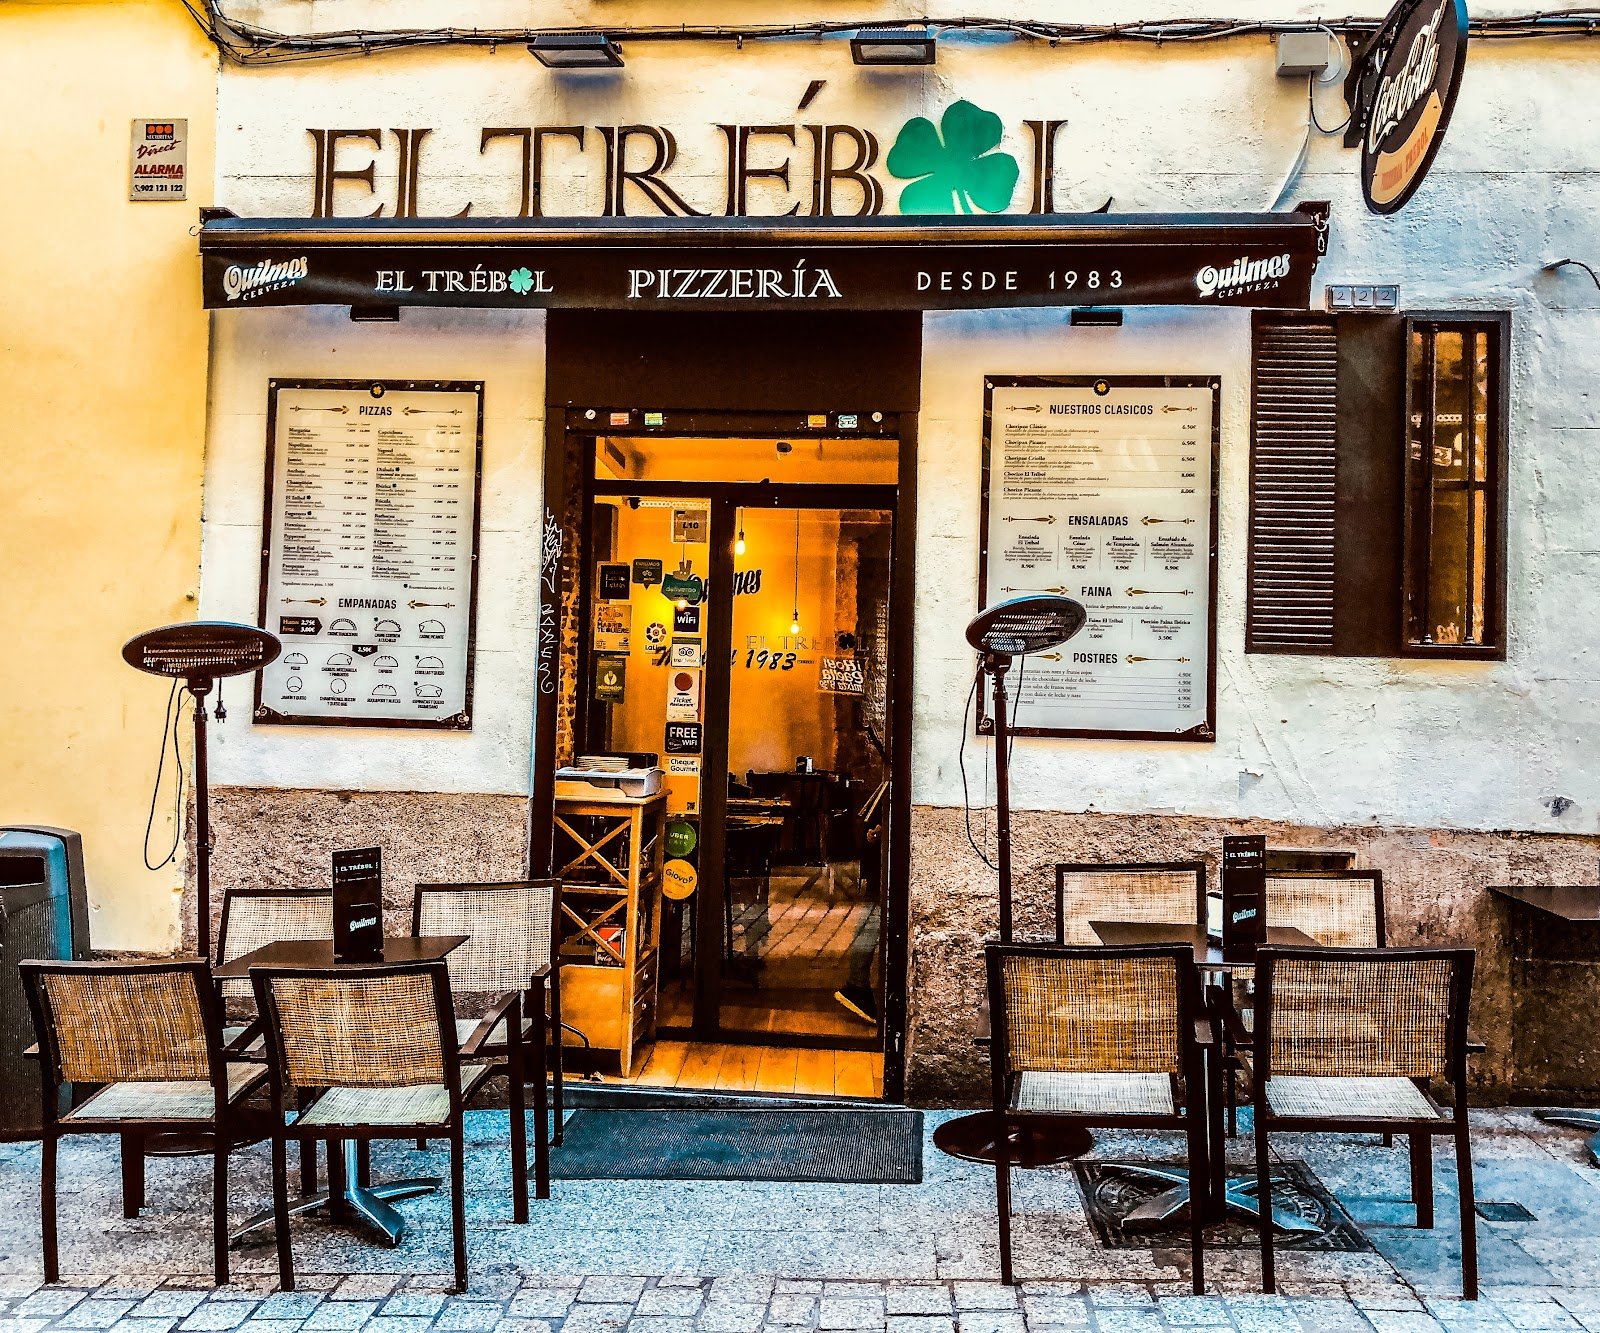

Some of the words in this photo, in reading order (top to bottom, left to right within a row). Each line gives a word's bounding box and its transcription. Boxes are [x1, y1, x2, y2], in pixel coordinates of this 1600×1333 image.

[136, 140, 182, 159] Direct
[305, 127, 473, 217] EL
[480, 80, 1113, 217] TRÉBL
[134, 164, 184, 174] ALARMA
[222, 256, 309, 302] Quilmes
[376, 270, 414, 292] EL
[422, 263, 554, 296] TRÉBL
[627, 259, 843, 300] PIZZERÍA
[916, 270, 1018, 291] DESDE
[1048, 270, 1124, 290] 1983
[1196, 254, 1290, 298] Quilmes
[242, 280, 296, 301] CERVEZA
[1218, 280, 1280, 299] CERVEZA
[360, 406, 392, 416] PIZZAS
[1050, 404, 1102, 415] NUESTROS
[1104, 405, 1153, 415] CLASICOS
[1068, 515, 1129, 526] ENSALADAS
[1081, 586, 1113, 597] FAINA
[338, 598, 397, 610] EMPANADAS
[677, 612, 696, 624] WiFi
[745, 649, 798, 670] 1983
[1073, 652, 1118, 664] POSTRES
[669, 726, 698, 738] FREE
[670, 832, 689, 840] UBER
[350, 916, 377, 932] Quilmes
[1232, 908, 1256, 924] Quilmes
